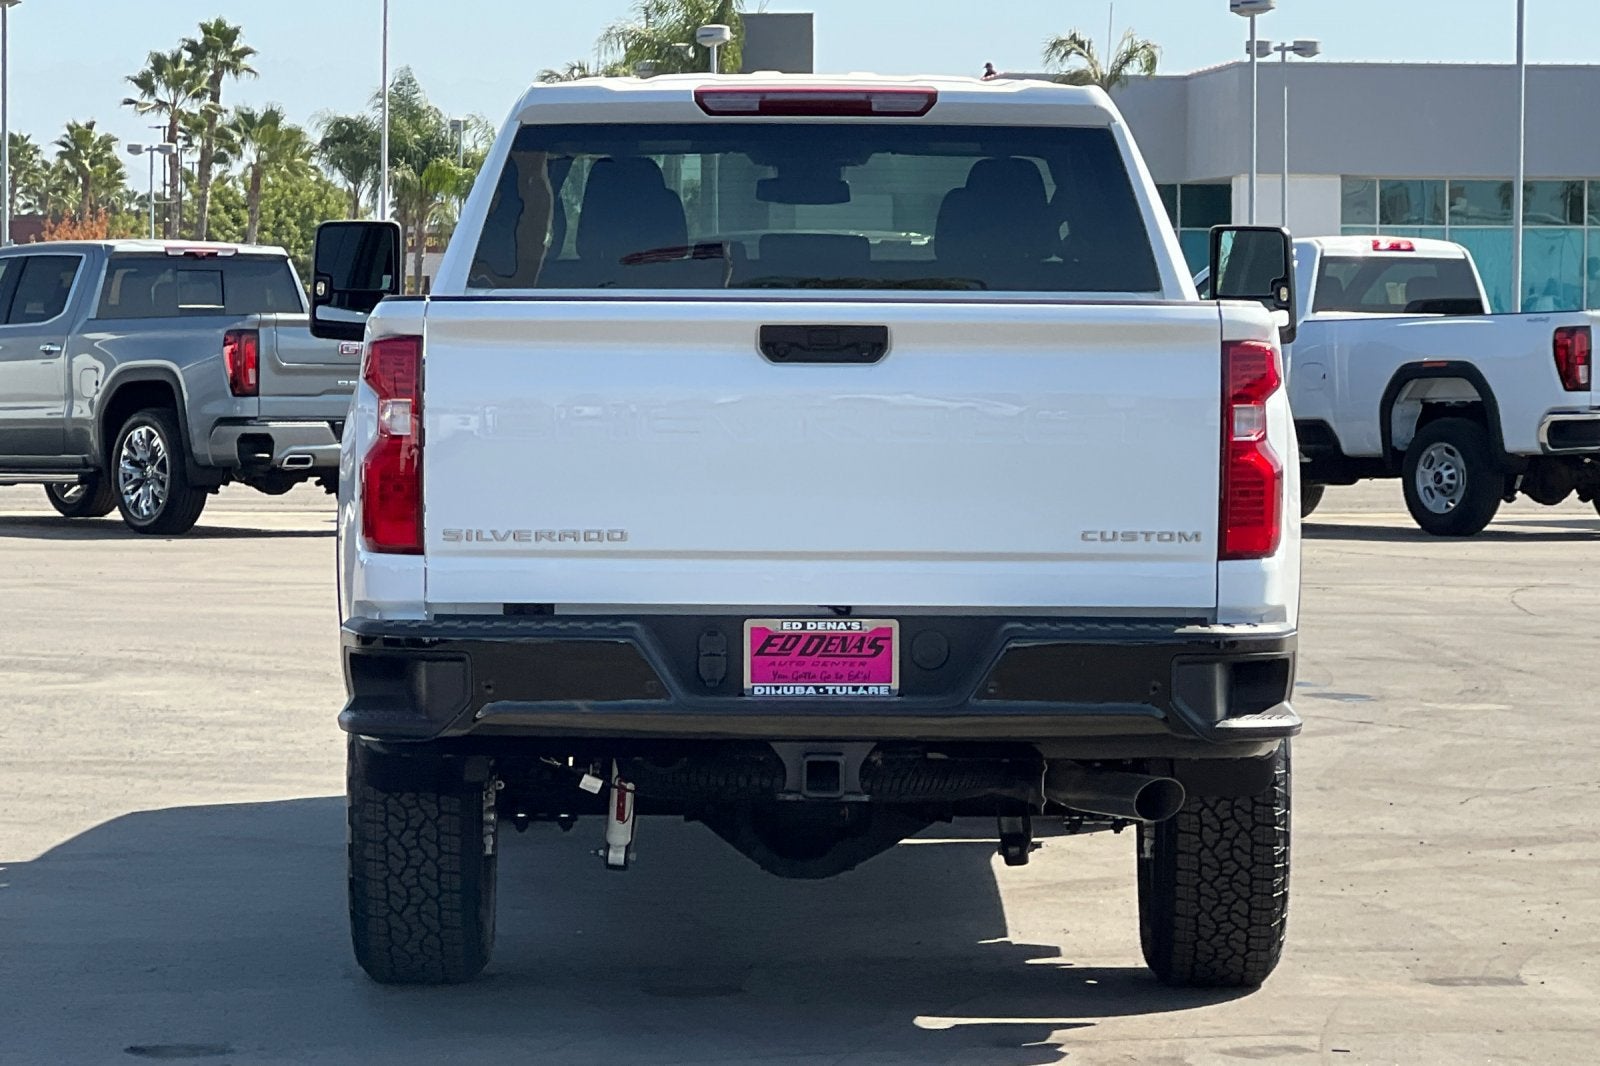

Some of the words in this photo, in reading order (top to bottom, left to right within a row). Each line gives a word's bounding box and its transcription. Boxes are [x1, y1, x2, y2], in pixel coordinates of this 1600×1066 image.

[442, 528, 628, 543] SILVERADO
[1081, 530, 1202, 542] CUSTOM
[782, 621, 802, 630] ED
[806, 621, 861, 630] DENA'S
[753, 634, 802, 656] ED
[798, 634, 891, 658] DENA'S
[772, 671, 788, 681] You
[819, 671, 832, 681] Go
